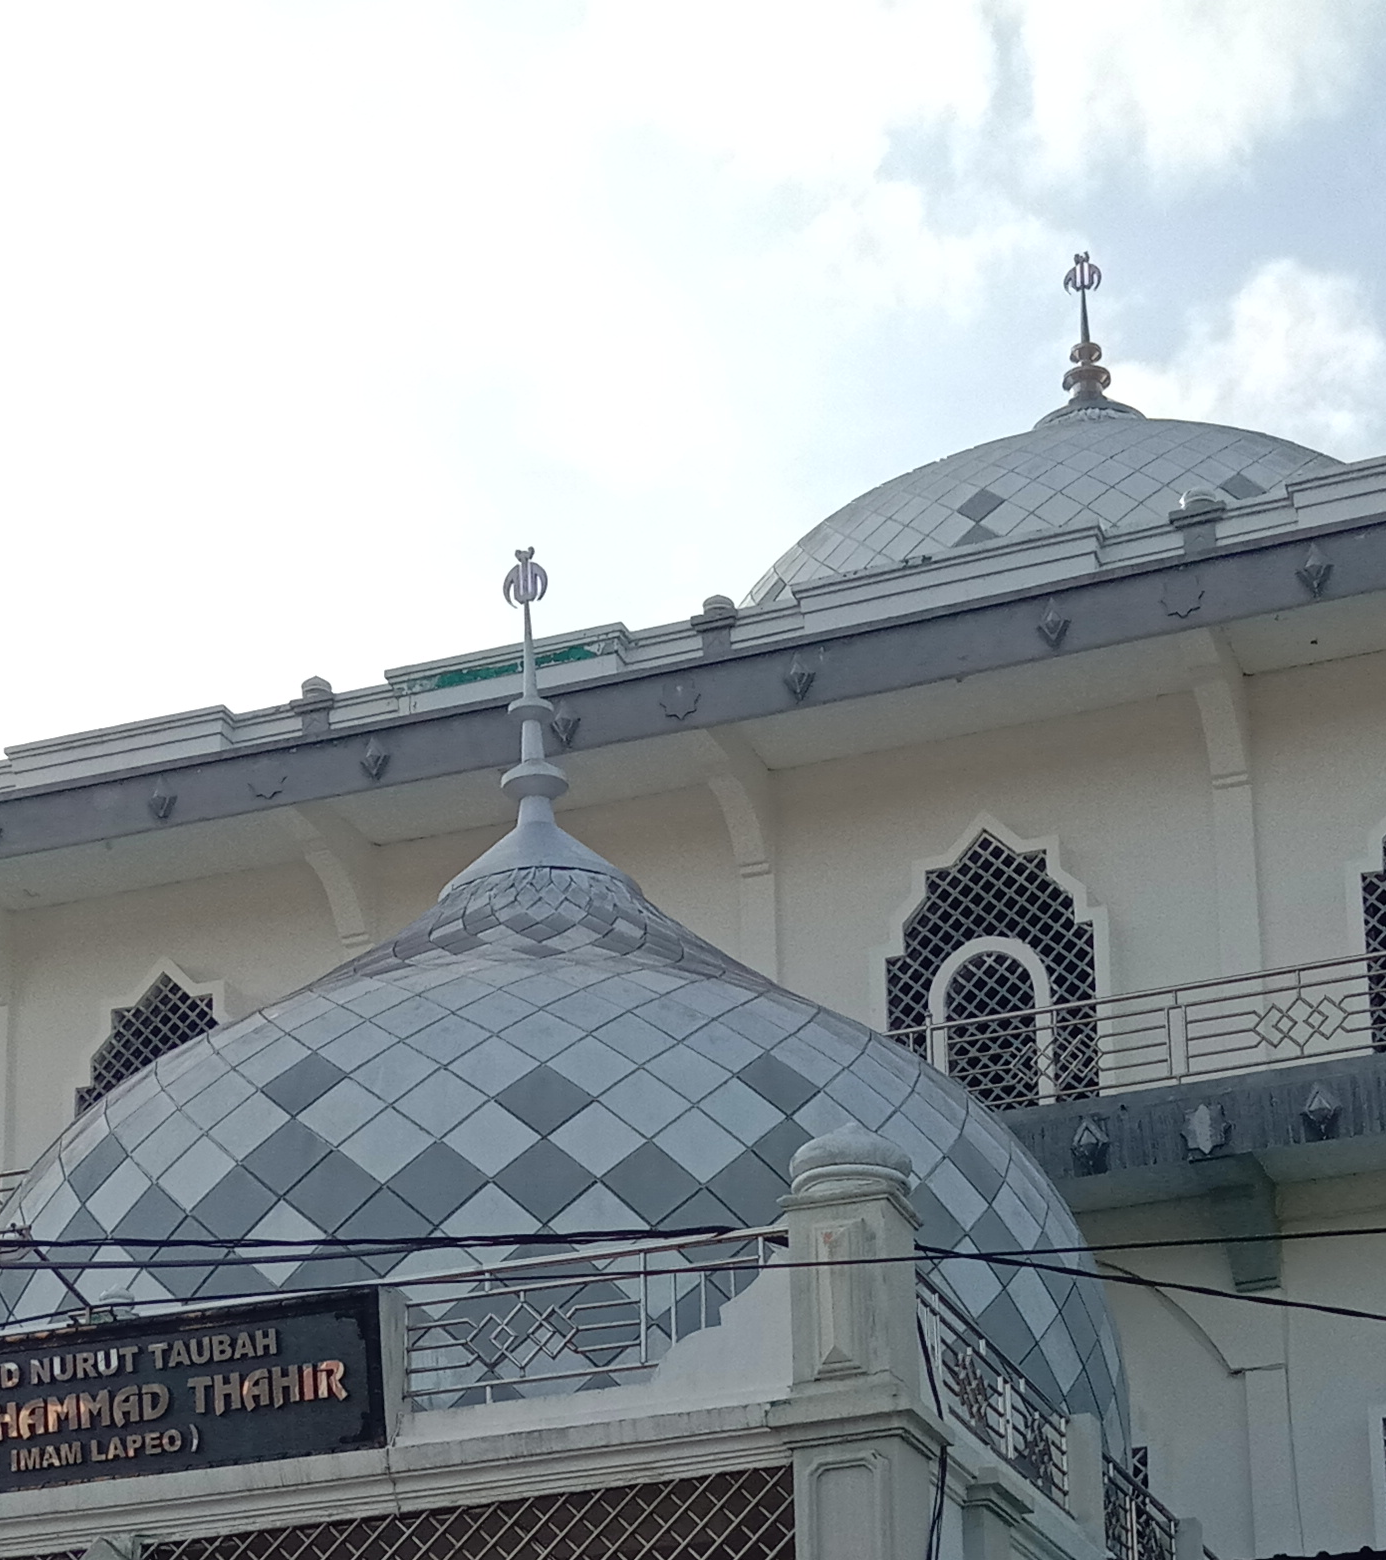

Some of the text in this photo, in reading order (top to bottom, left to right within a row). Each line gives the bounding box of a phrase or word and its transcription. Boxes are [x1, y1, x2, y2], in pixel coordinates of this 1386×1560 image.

[30, 1346, 139, 1385] NURUT
[148, 1328, 277, 1369] TAUBAH
[187, 1360, 348, 1416] THAHIR
